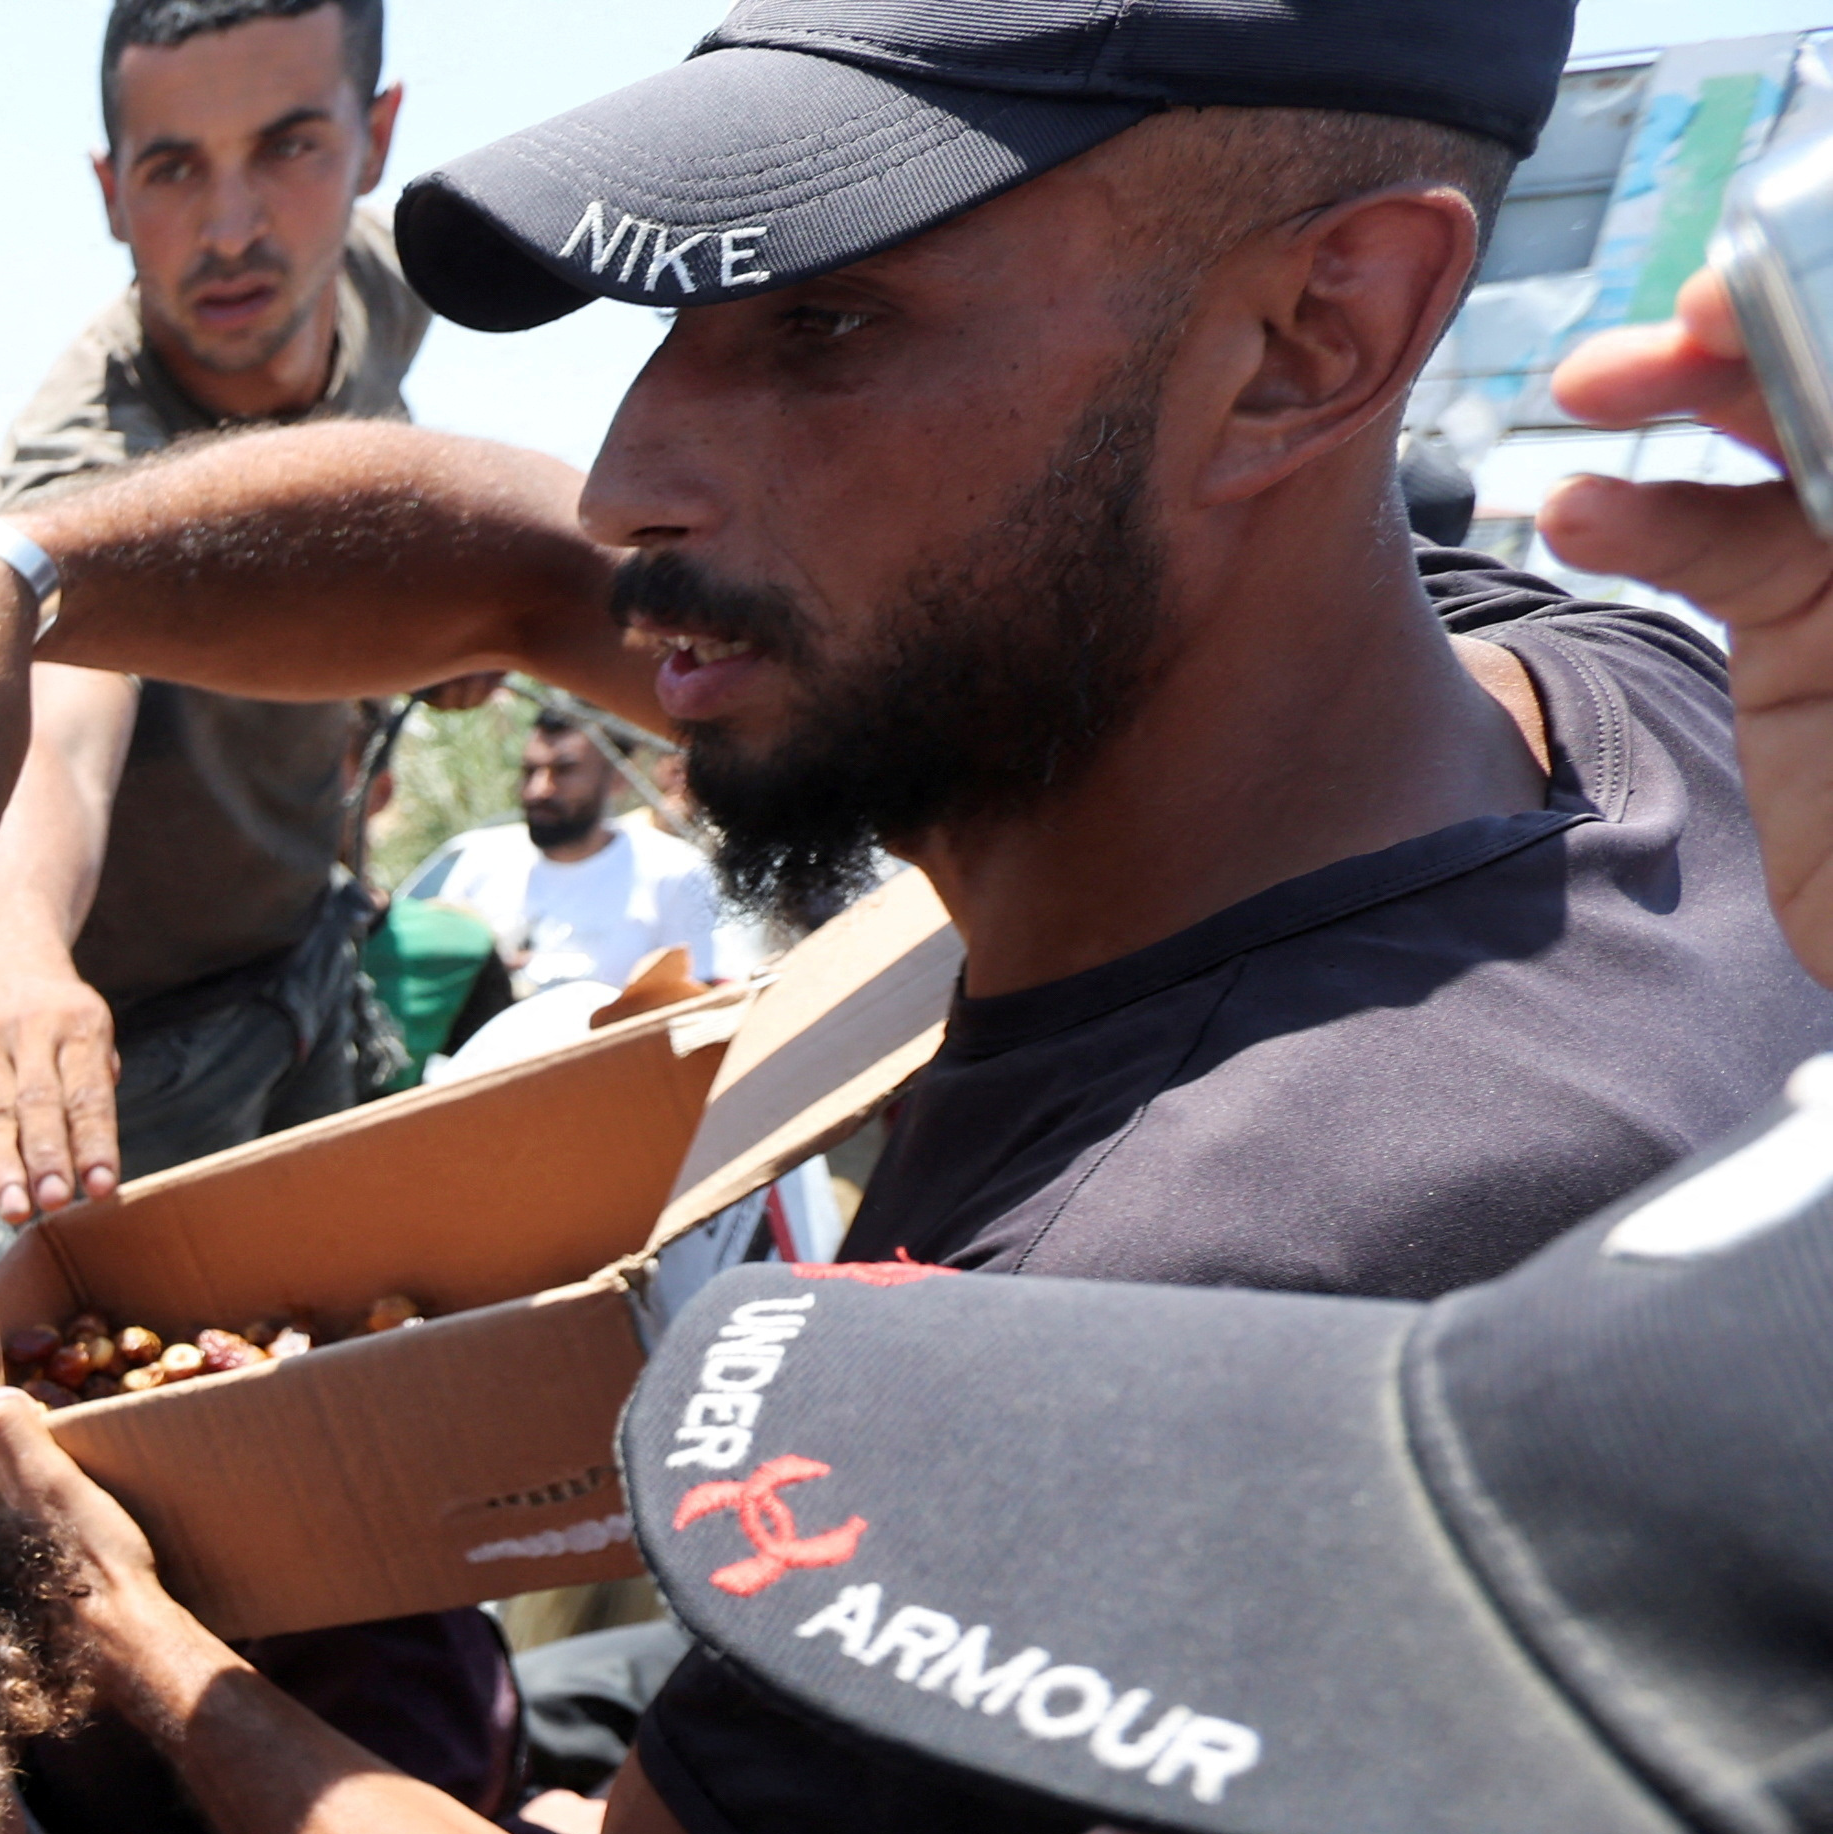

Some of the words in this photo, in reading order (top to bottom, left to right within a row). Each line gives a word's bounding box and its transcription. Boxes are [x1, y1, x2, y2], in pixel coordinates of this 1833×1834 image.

[558, 201, 771, 294] NIKE
[666, 1292, 816, 1470] UNDER
[795, 1583, 1262, 1802] ARMOUR
